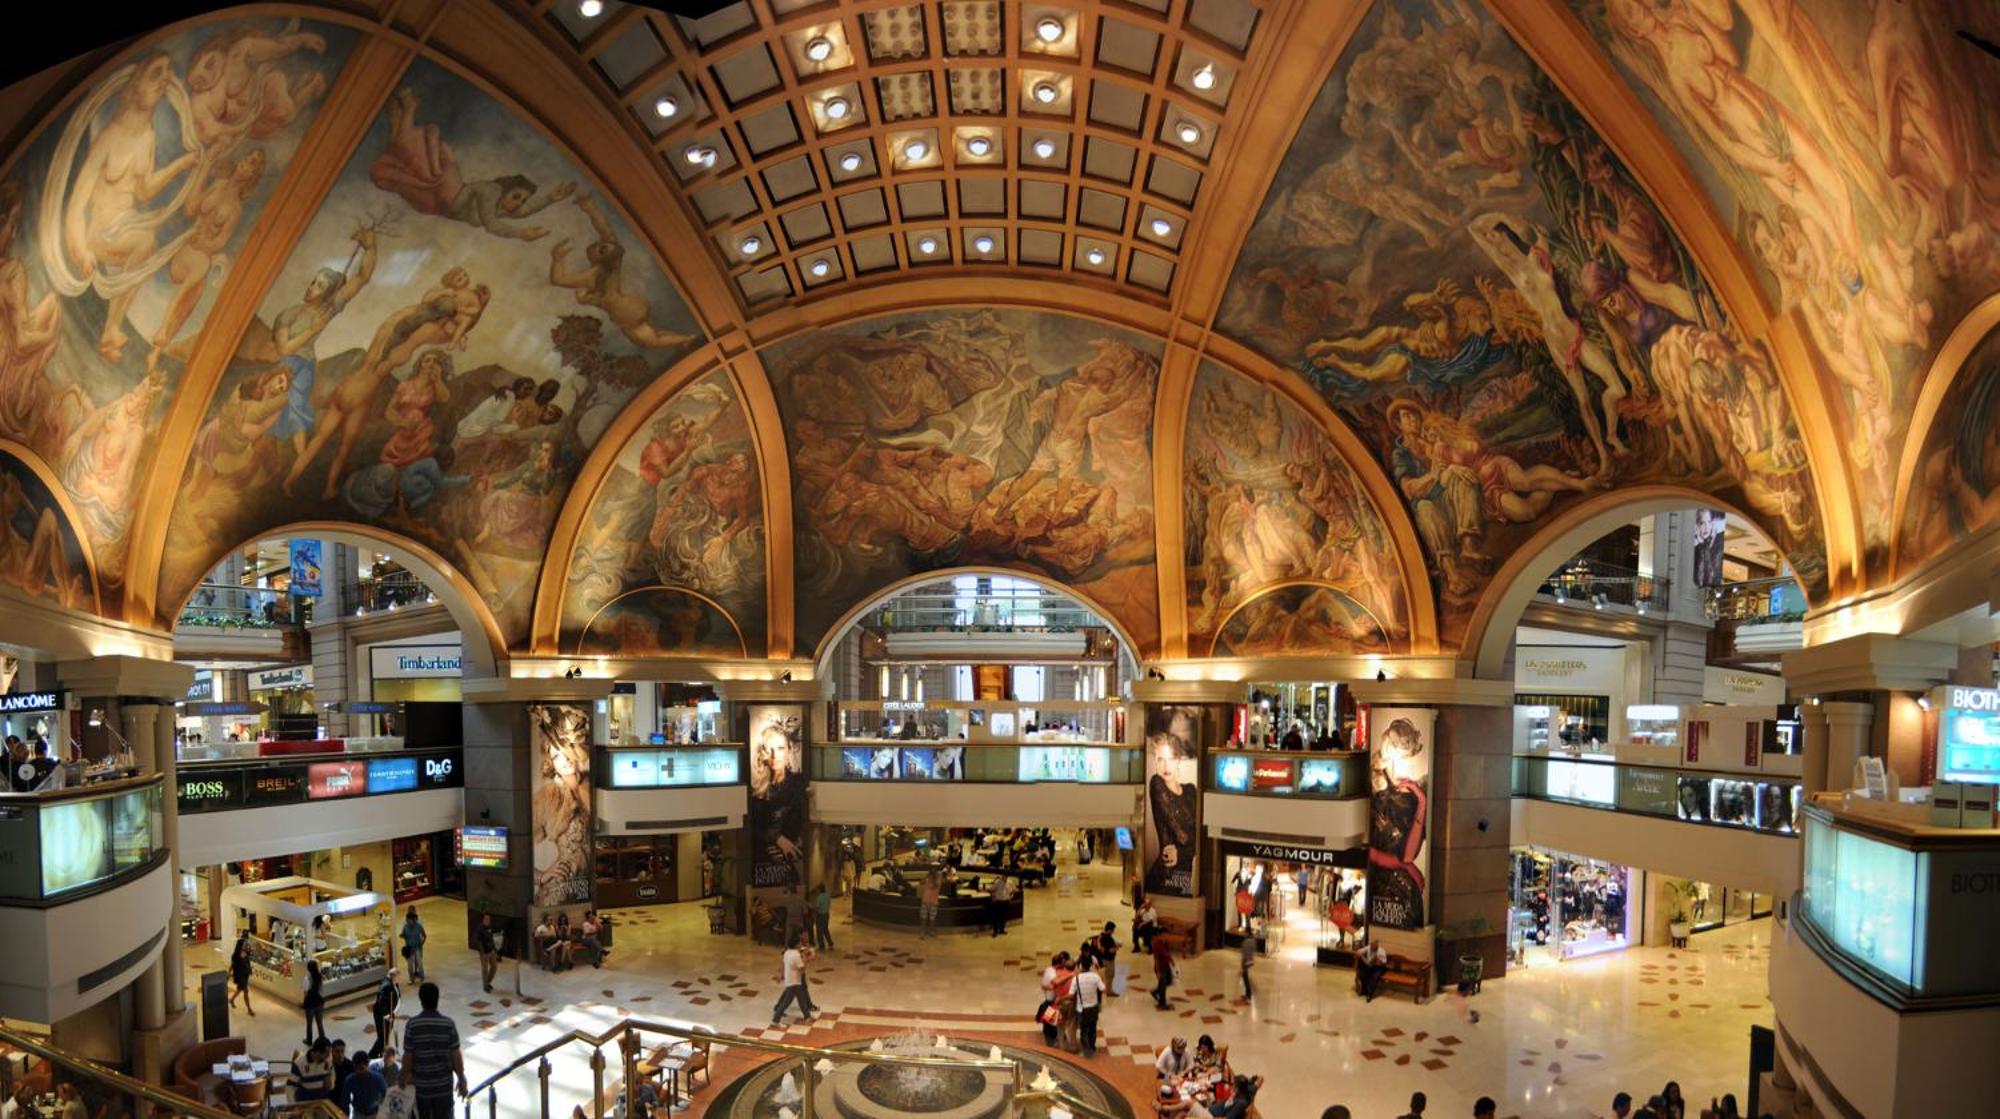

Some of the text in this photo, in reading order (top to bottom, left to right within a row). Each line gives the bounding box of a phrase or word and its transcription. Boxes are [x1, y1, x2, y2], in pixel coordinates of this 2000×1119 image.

[397, 655, 462, 670] Timberland
[426, 759, 452, 776] D&G
[186, 781, 224, 796] BOSS
[1253, 845, 1334, 863] YAGMOUR
